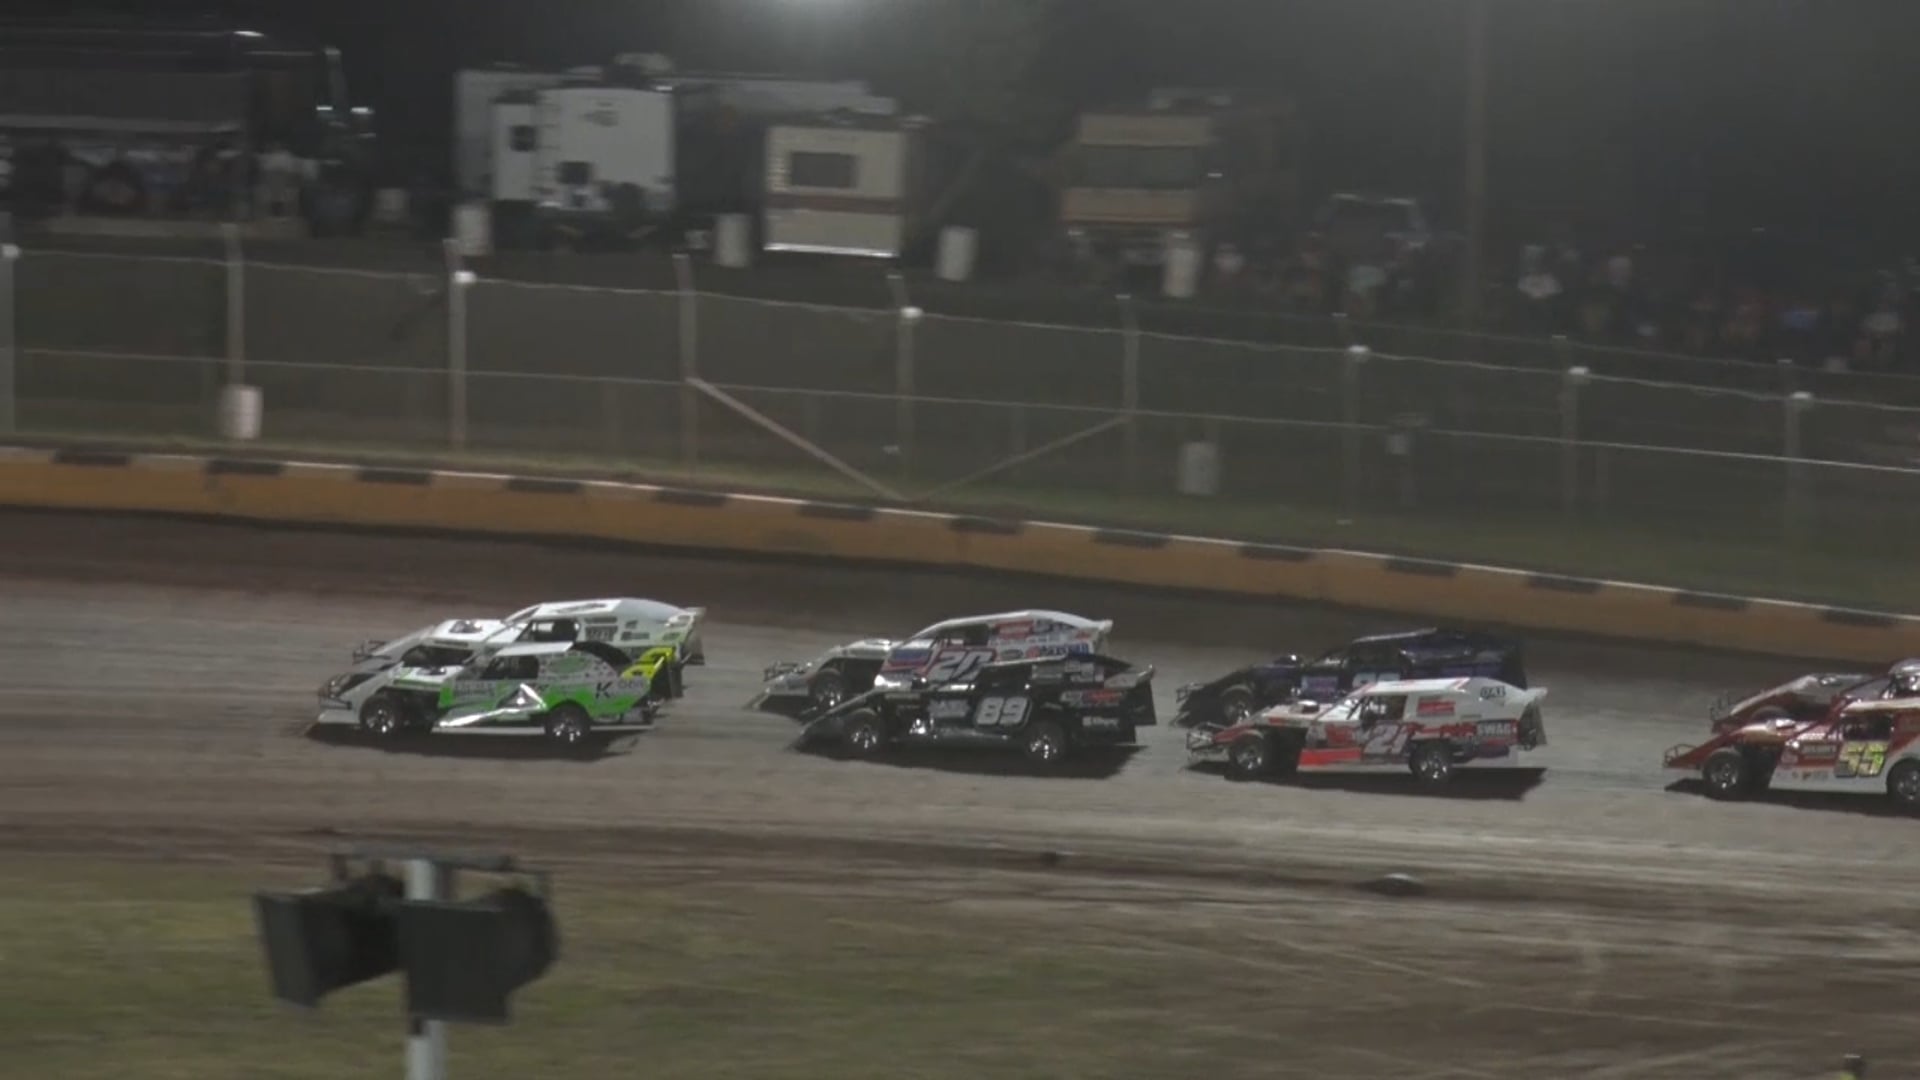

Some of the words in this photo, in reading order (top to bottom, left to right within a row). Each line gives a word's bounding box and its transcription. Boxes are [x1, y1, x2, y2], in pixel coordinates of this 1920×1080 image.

[977, 697, 1028, 725] 89
[1363, 724, 1408, 755] 21
[1838, 741, 1889, 778] 55
